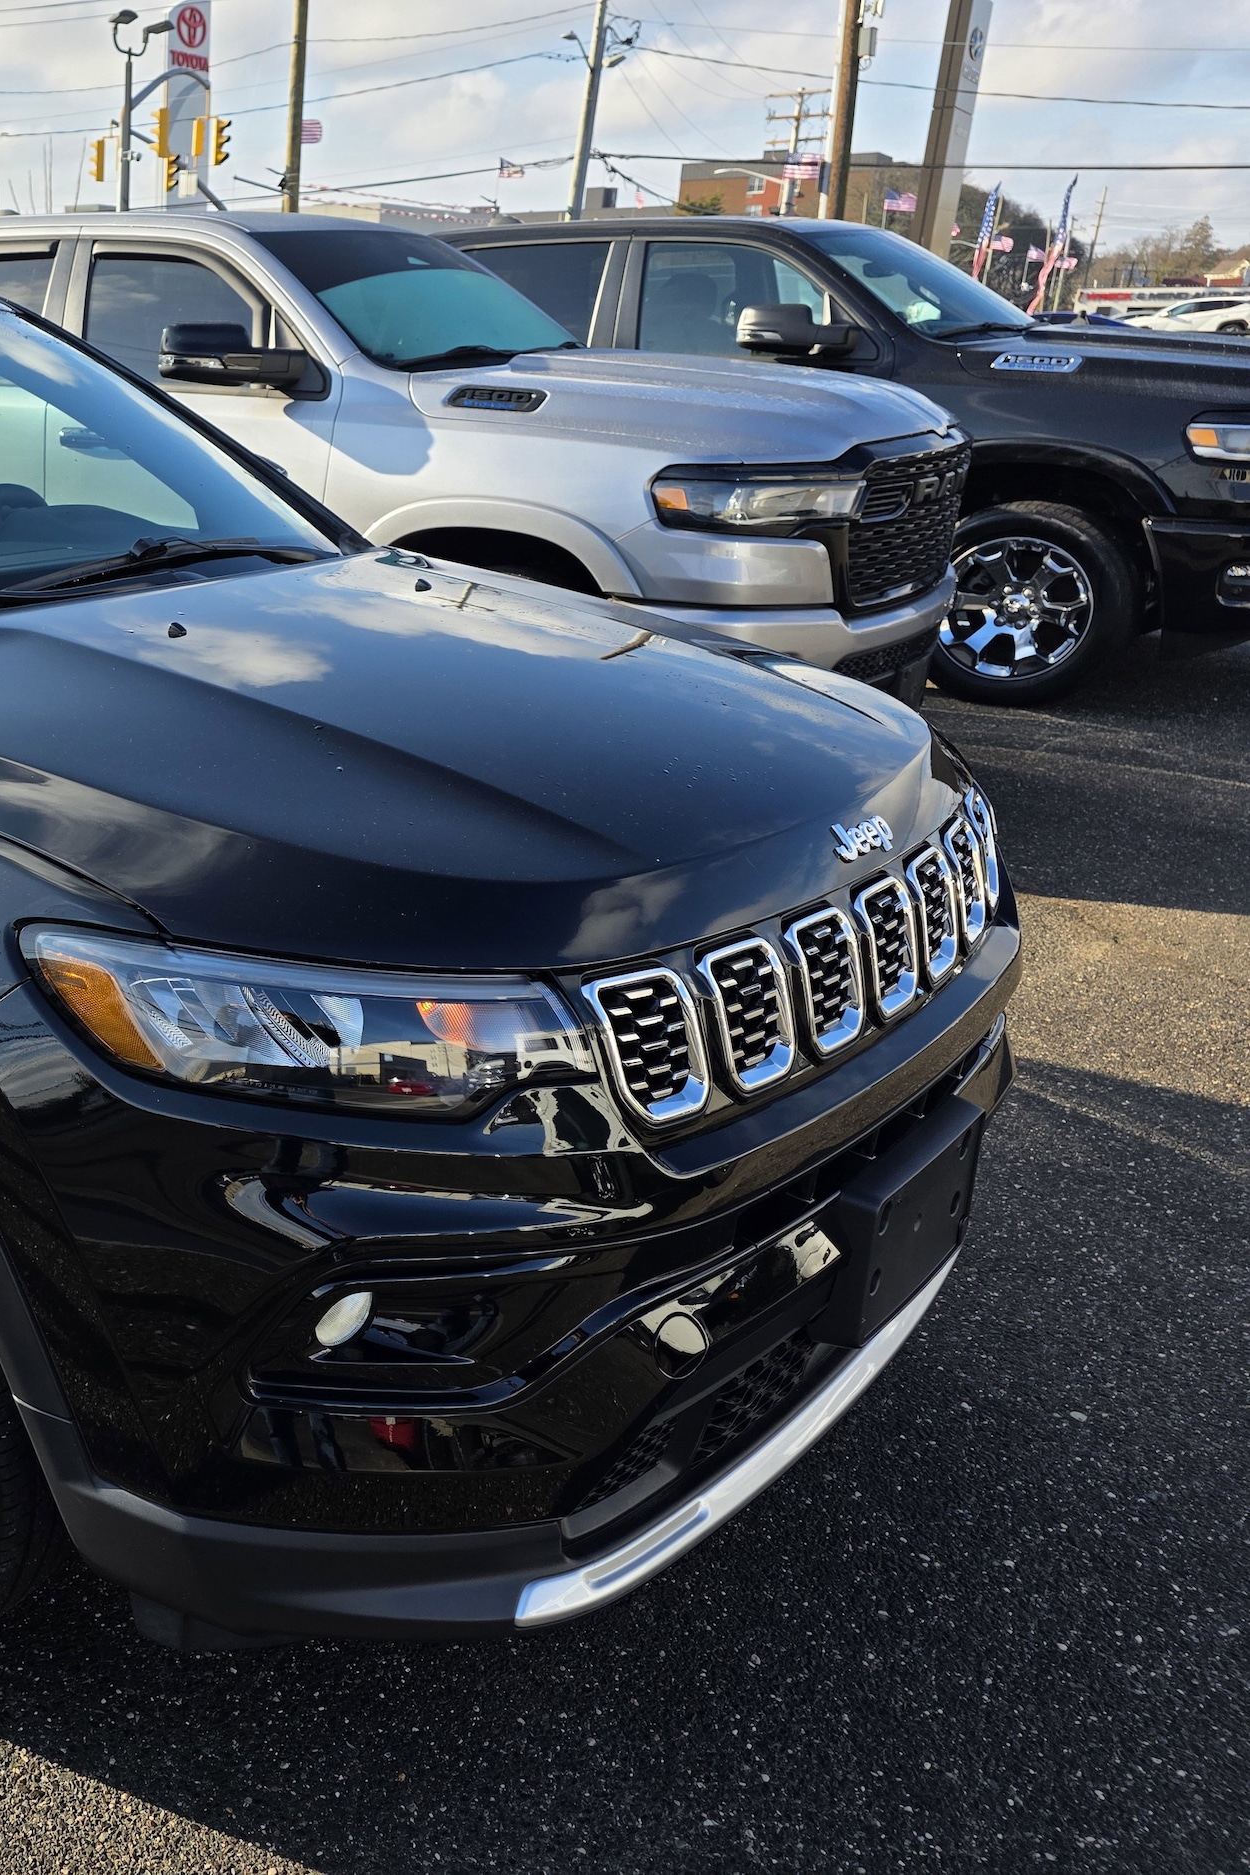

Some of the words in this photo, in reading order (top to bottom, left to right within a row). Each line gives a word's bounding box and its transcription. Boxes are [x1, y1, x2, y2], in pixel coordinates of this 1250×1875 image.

[170, 49, 209, 72] TOYOTA
[1001, 355, 1068, 366] 1500
[457, 389, 530, 402] 1500
[829, 815, 894, 864] Jeep
